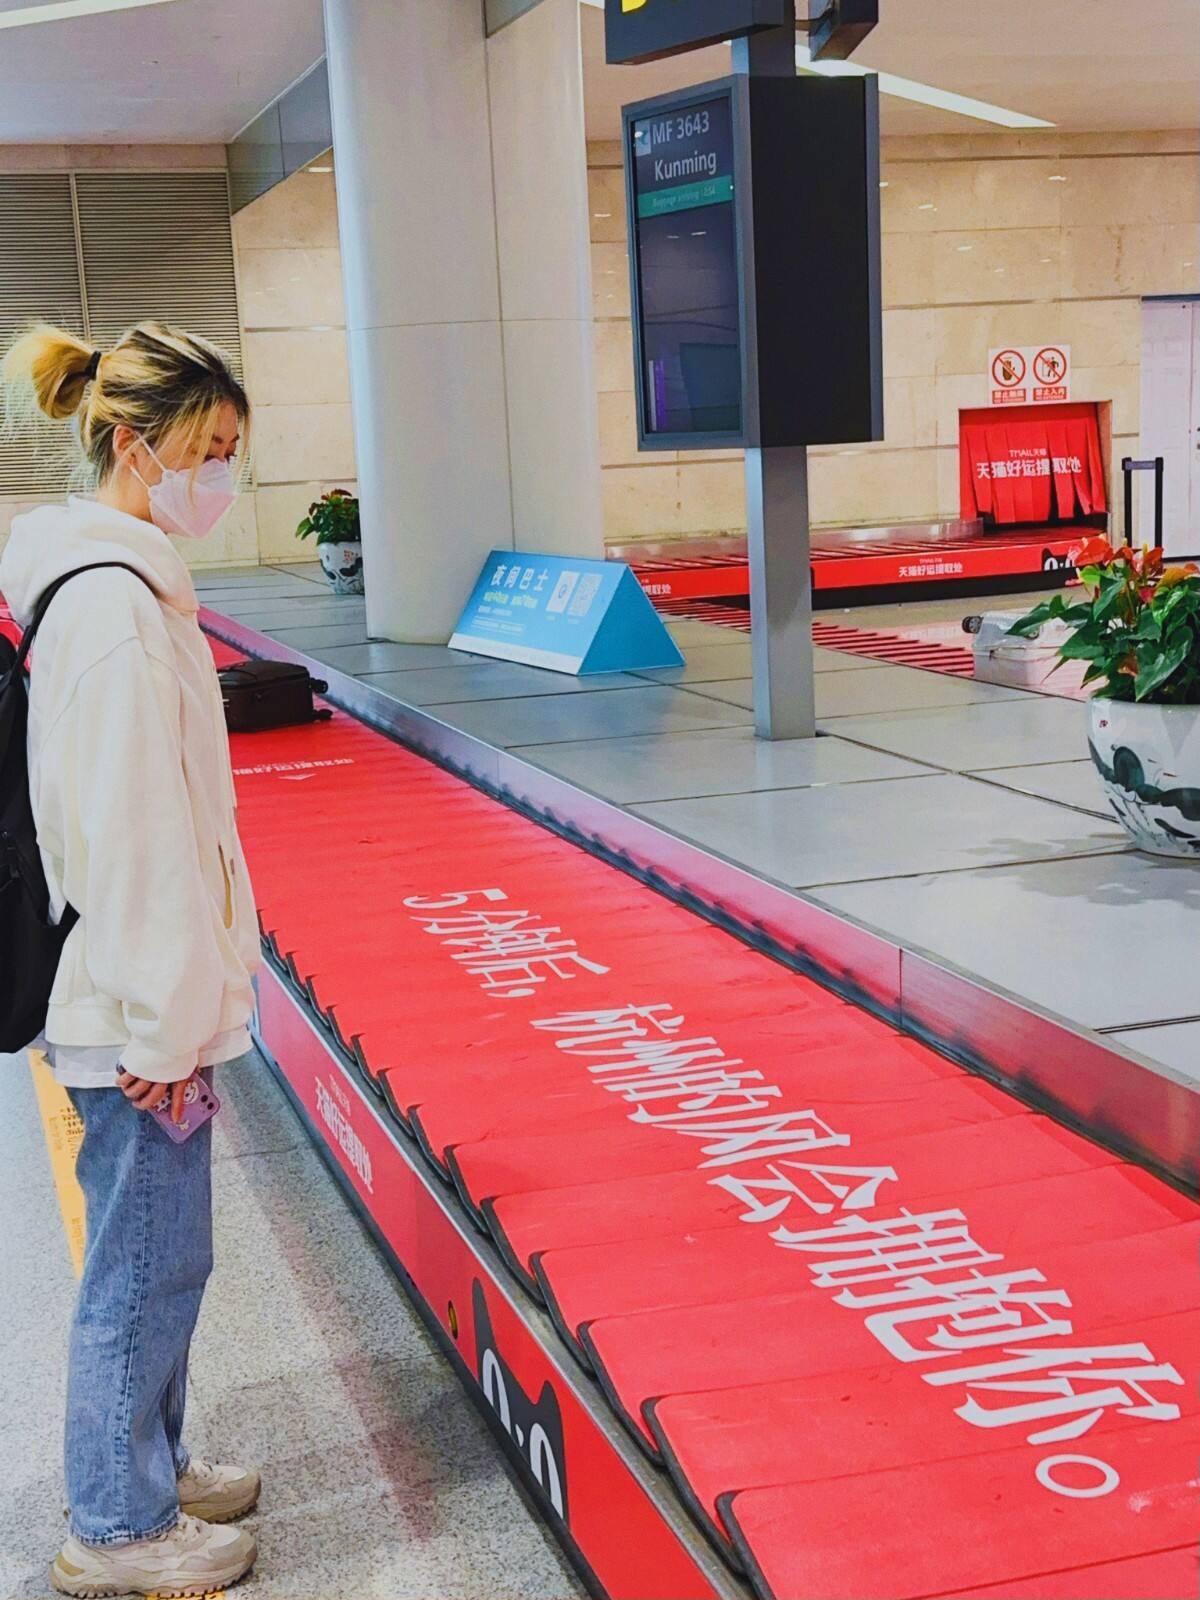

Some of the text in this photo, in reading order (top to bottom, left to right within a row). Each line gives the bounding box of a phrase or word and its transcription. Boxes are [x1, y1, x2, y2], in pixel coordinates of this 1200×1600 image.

[653, 110, 710, 144] MF 3643
[655, 150, 717, 181] Kunming
[976, 456, 1082, 480] 天猫好运提取处
[898, 561, 964, 578] 天猫好运提取处
[402, 887, 1182, 1499] 5分钟后，杭州的风会拥抱你。
